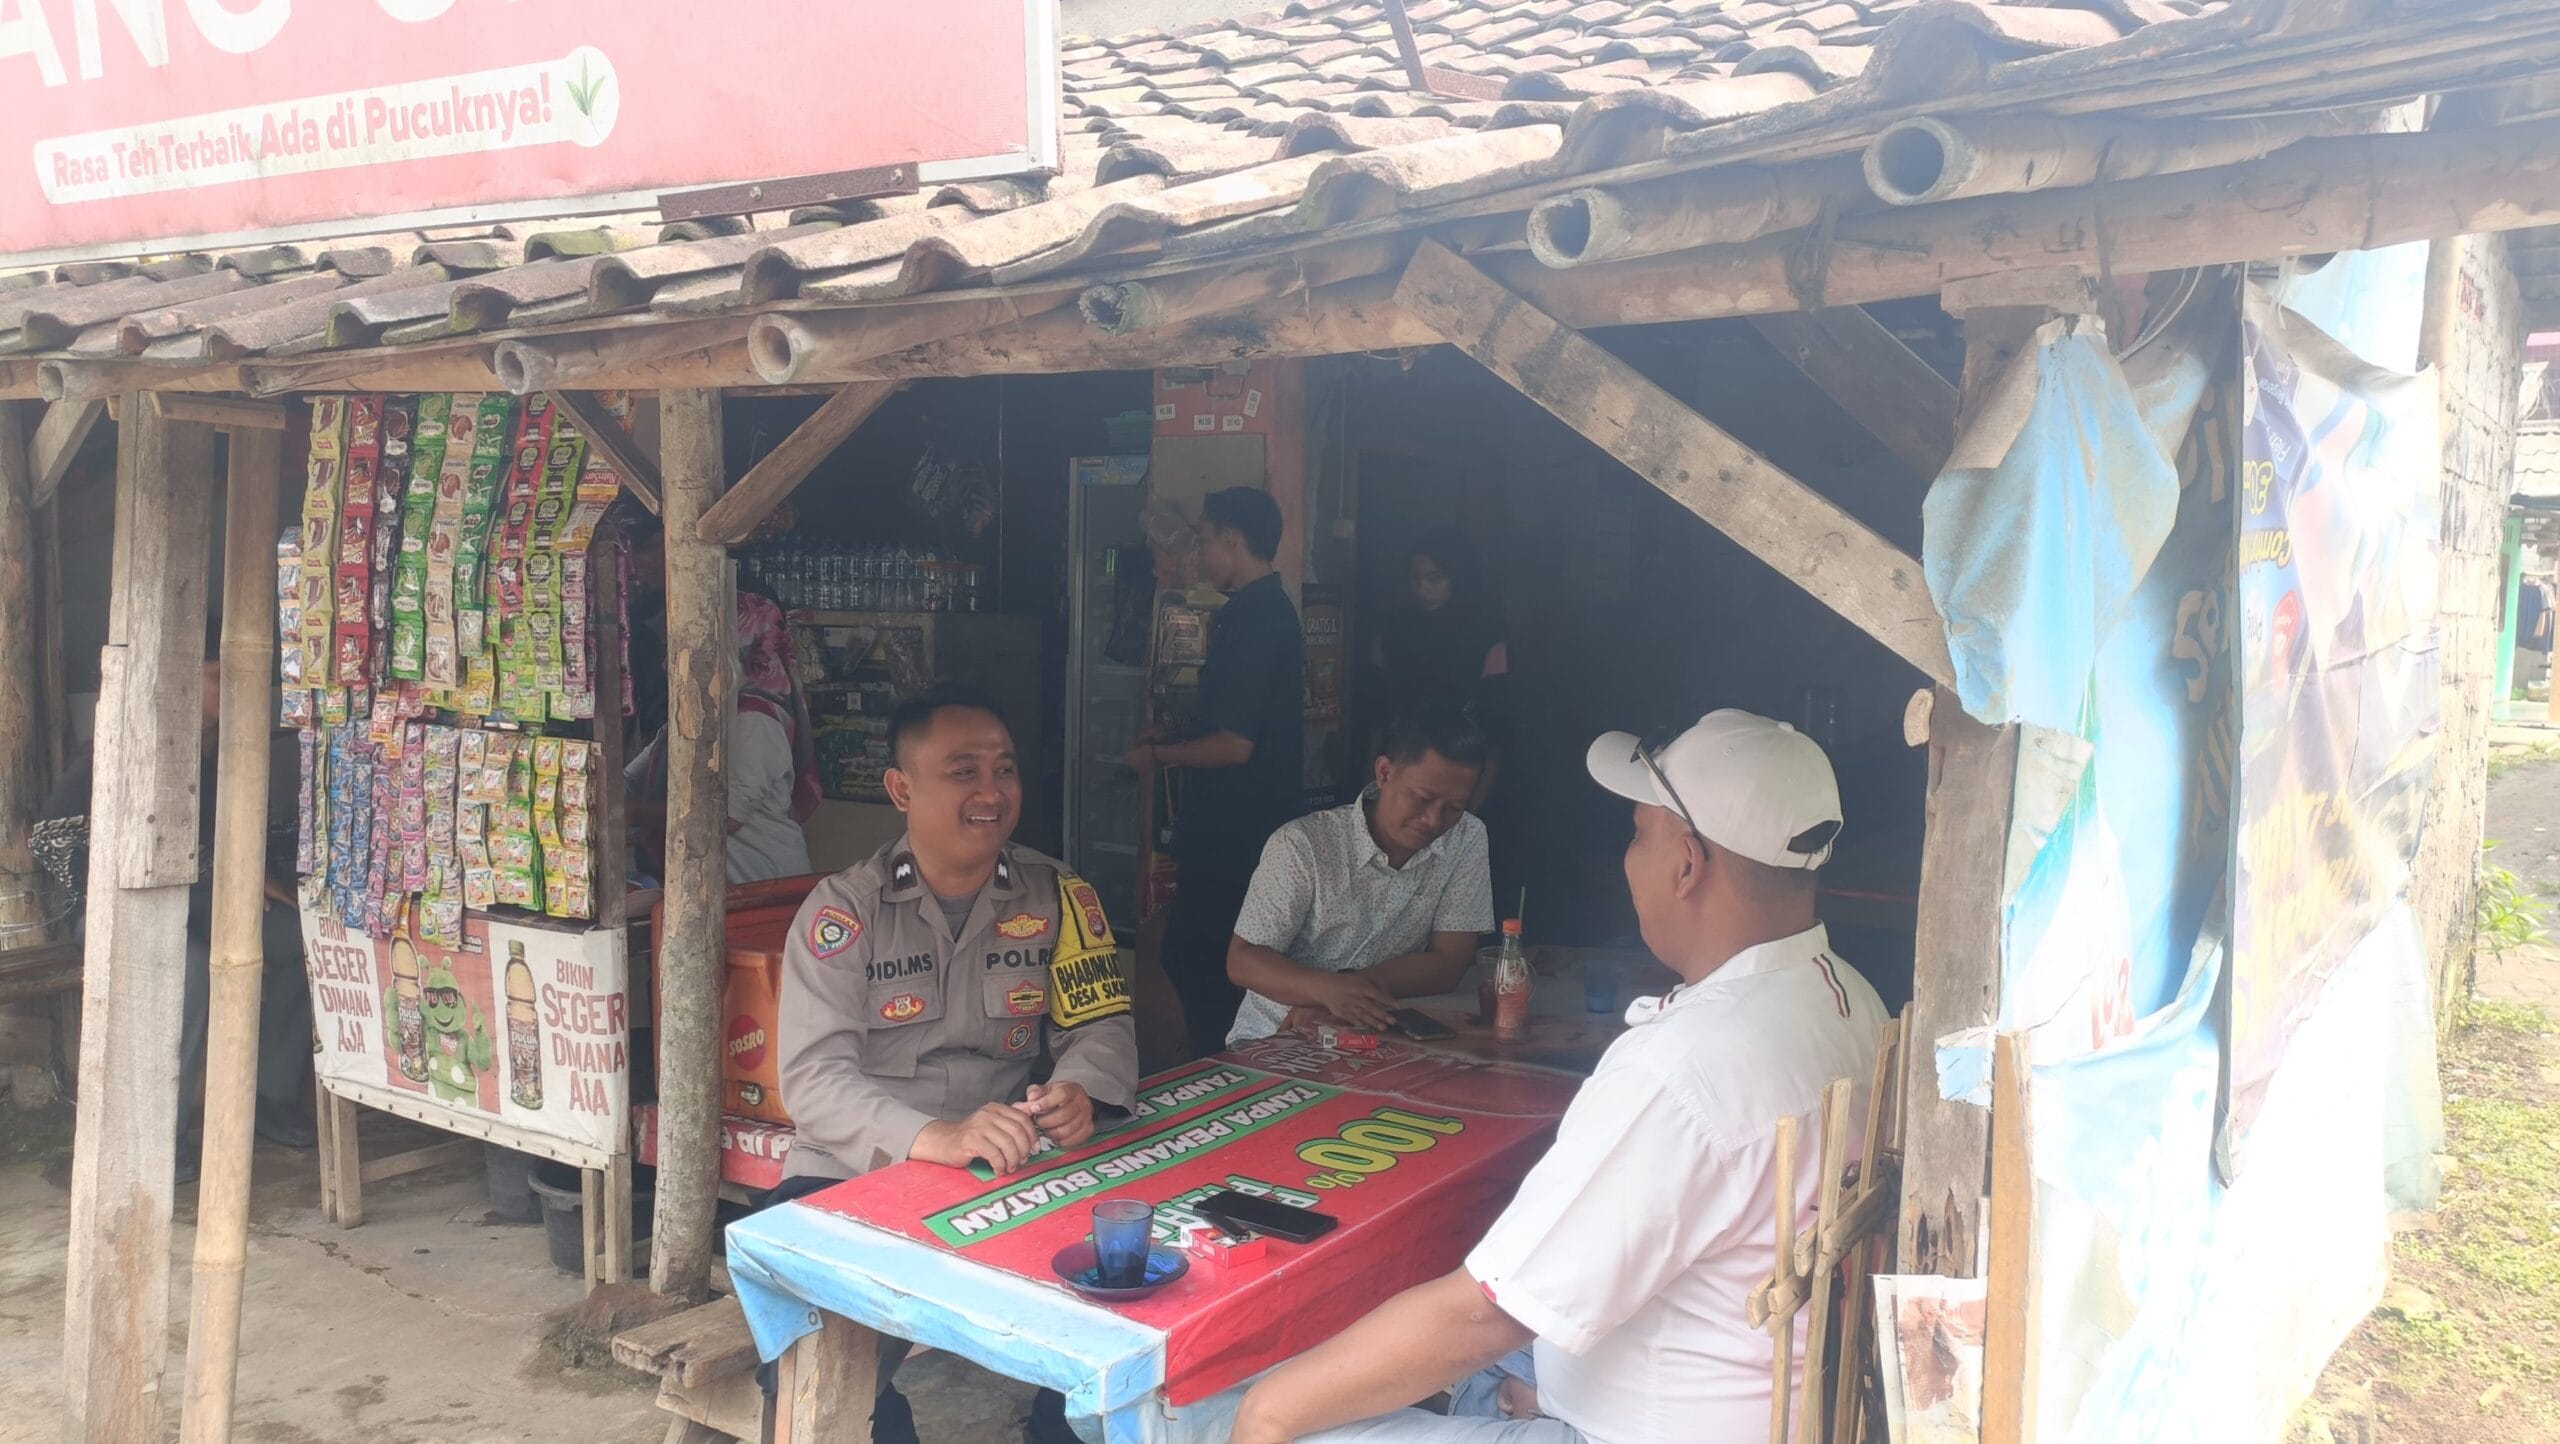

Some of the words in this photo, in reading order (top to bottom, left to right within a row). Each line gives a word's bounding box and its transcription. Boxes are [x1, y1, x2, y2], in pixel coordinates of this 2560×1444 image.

[52, 150, 109, 188] Rasa
[112, 139, 158, 179] Teh
[162, 128, 257, 172] Terbaik
[259, 111, 319, 161] Ada
[326, 97, 356, 149] di
[366, 72, 552, 145] Pucuknya!
[319, 916, 348, 943] BIKIN
[312, 937, 370, 985] SEGER
[556, 958, 594, 992] BIKIN
[319, 984, 373, 1018] DIMANA
[541, 983, 625, 1036] SEGER
[1068, 987, 1099, 1010] DESA
[338, 1016, 366, 1054] AJA
[729, 1028, 764, 1057] SOSRO
[1150, 1070, 1247, 1107] TANPA
[1223, 1084, 1320, 1129] TANPA
[1093, 1119, 1233, 1180] PEMANIS
[1305, 1109, 1464, 1190] 100%
[947, 1168, 1100, 1237] BUATAN
